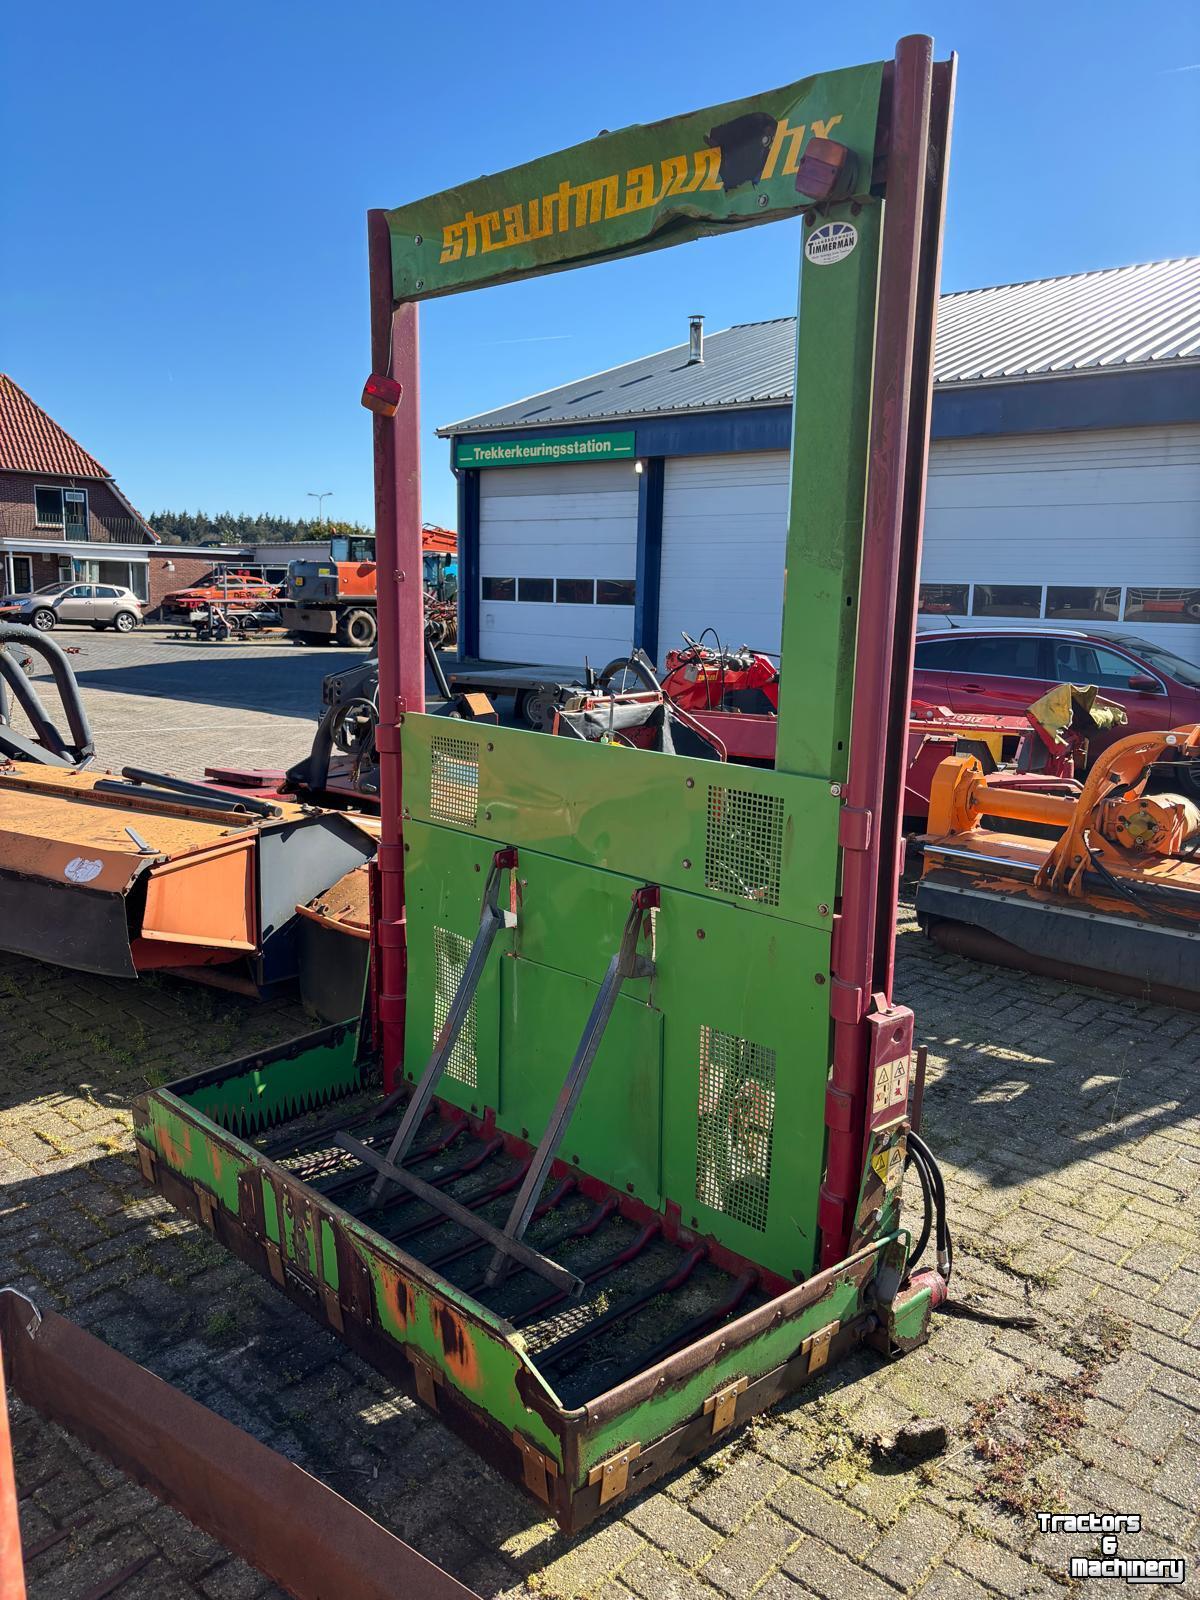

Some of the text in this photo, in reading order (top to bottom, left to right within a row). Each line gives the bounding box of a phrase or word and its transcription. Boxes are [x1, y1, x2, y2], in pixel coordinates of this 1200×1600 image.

[439, 146, 724, 264] strautmann
[807, 236, 855, 255] TIMMERMAN
[474, 439, 611, 460] Trekkerkeuringsstation
